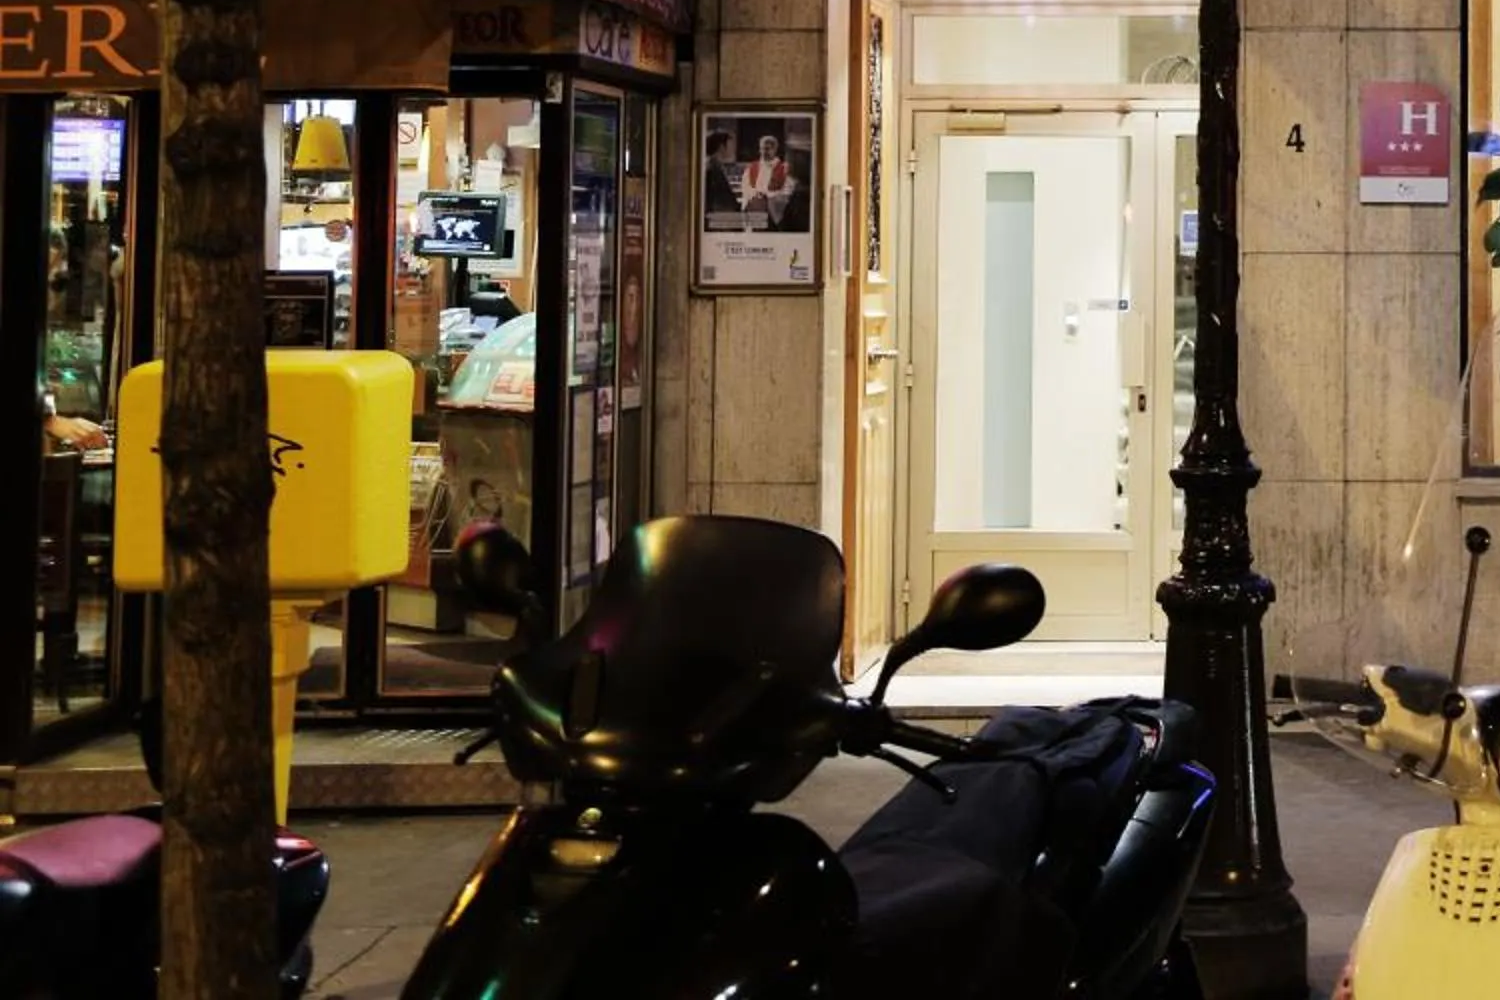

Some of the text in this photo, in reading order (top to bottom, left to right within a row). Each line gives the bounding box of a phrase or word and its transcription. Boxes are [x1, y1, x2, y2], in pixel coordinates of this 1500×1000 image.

[0, 3, 163, 79] ER
[1399, 101, 1440, 136] H
[1286, 124, 1305, 152] 4
